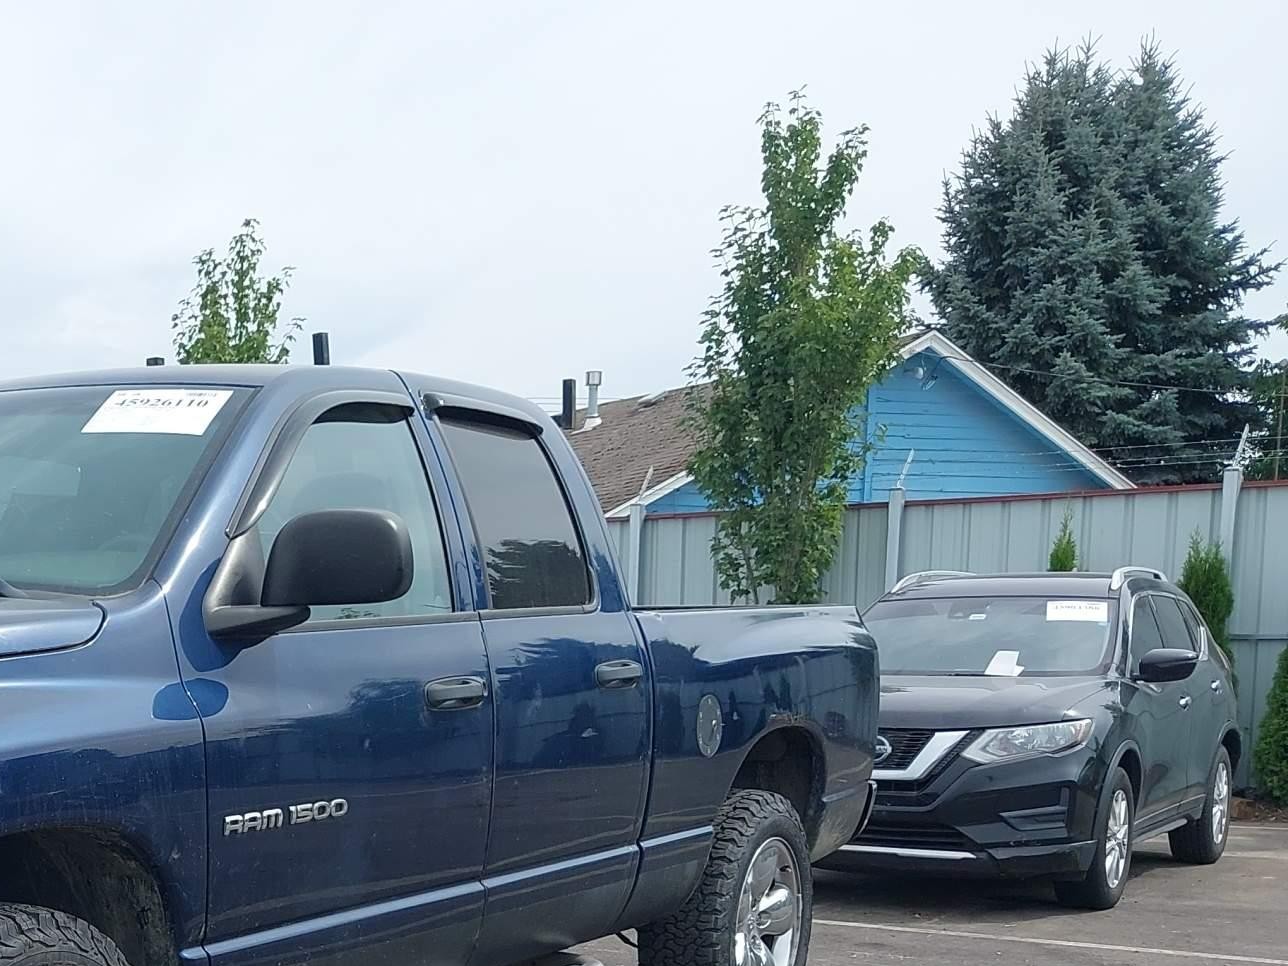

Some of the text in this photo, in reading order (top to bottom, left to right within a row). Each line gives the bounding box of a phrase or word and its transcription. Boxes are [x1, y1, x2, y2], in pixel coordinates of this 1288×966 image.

[115, 398, 209, 408] 45926110
[224, 798, 349, 836] RAM 1500
